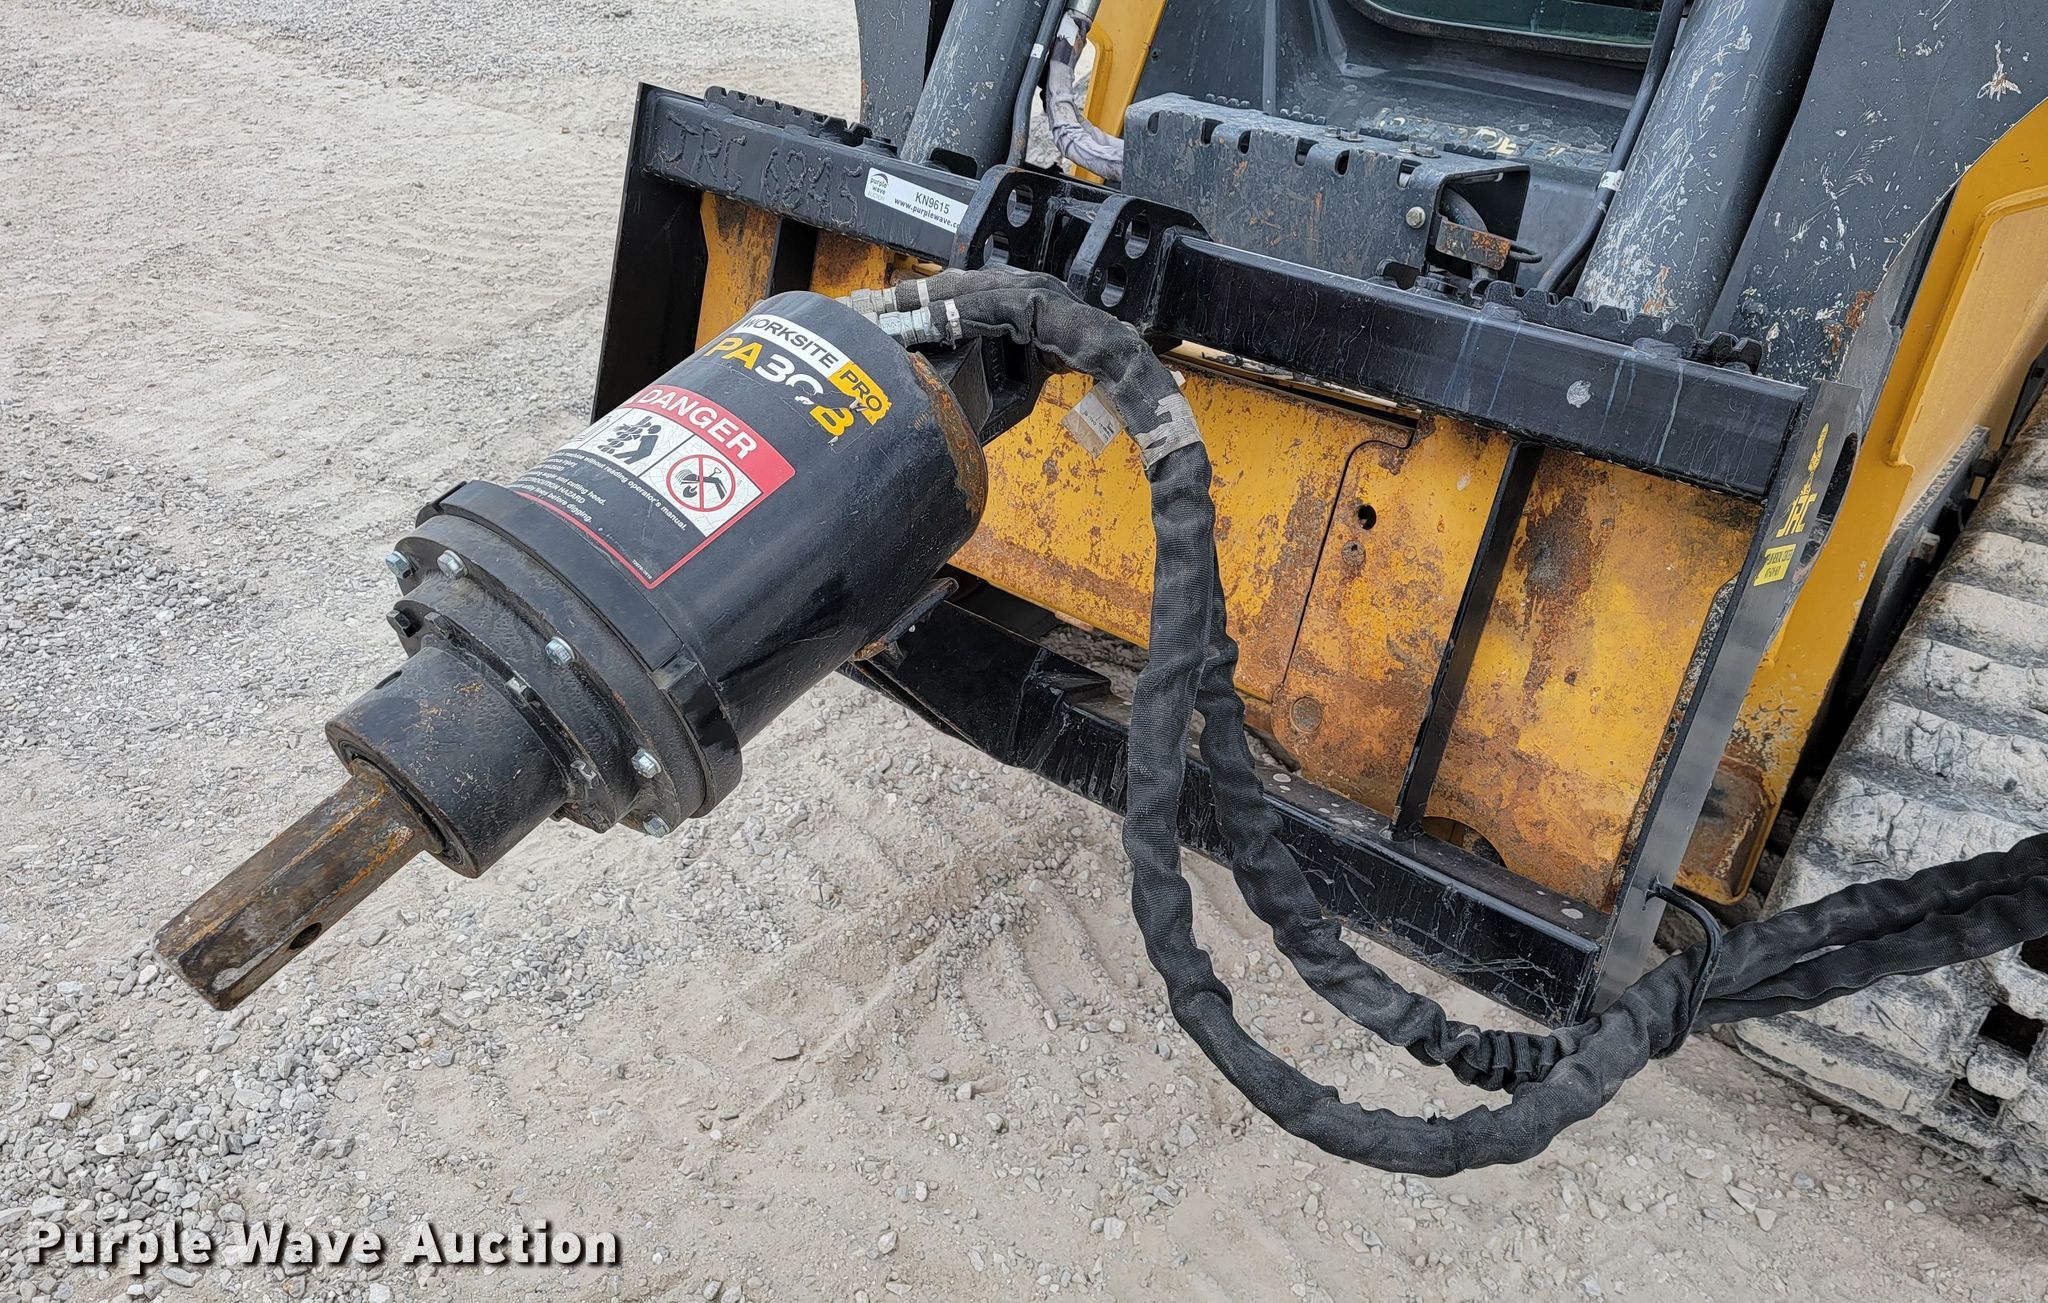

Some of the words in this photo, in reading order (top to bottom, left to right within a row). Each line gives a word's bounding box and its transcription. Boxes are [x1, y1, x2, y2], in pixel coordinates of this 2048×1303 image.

[869, 177, 888, 189] purple
[872, 186, 886, 195] wave
[915, 192, 950, 214] KN9615
[743, 318, 839, 369] WORKSITE
[839, 369, 883, 412] PRO
[639, 388, 758, 460] DANGER
[556, 476, 569, 484] and
[566, 480, 589, 495] cutting
[587, 491, 607, 506] head.
[557, 486, 586, 504] HAZARD
[583, 456, 606, 469] without
[604, 465, 630, 484] reading
[627, 480, 662, 508] operator's
[660, 505, 688, 531] manual.
[547, 492, 568, 506] before
[566, 503, 593, 523] digging.
